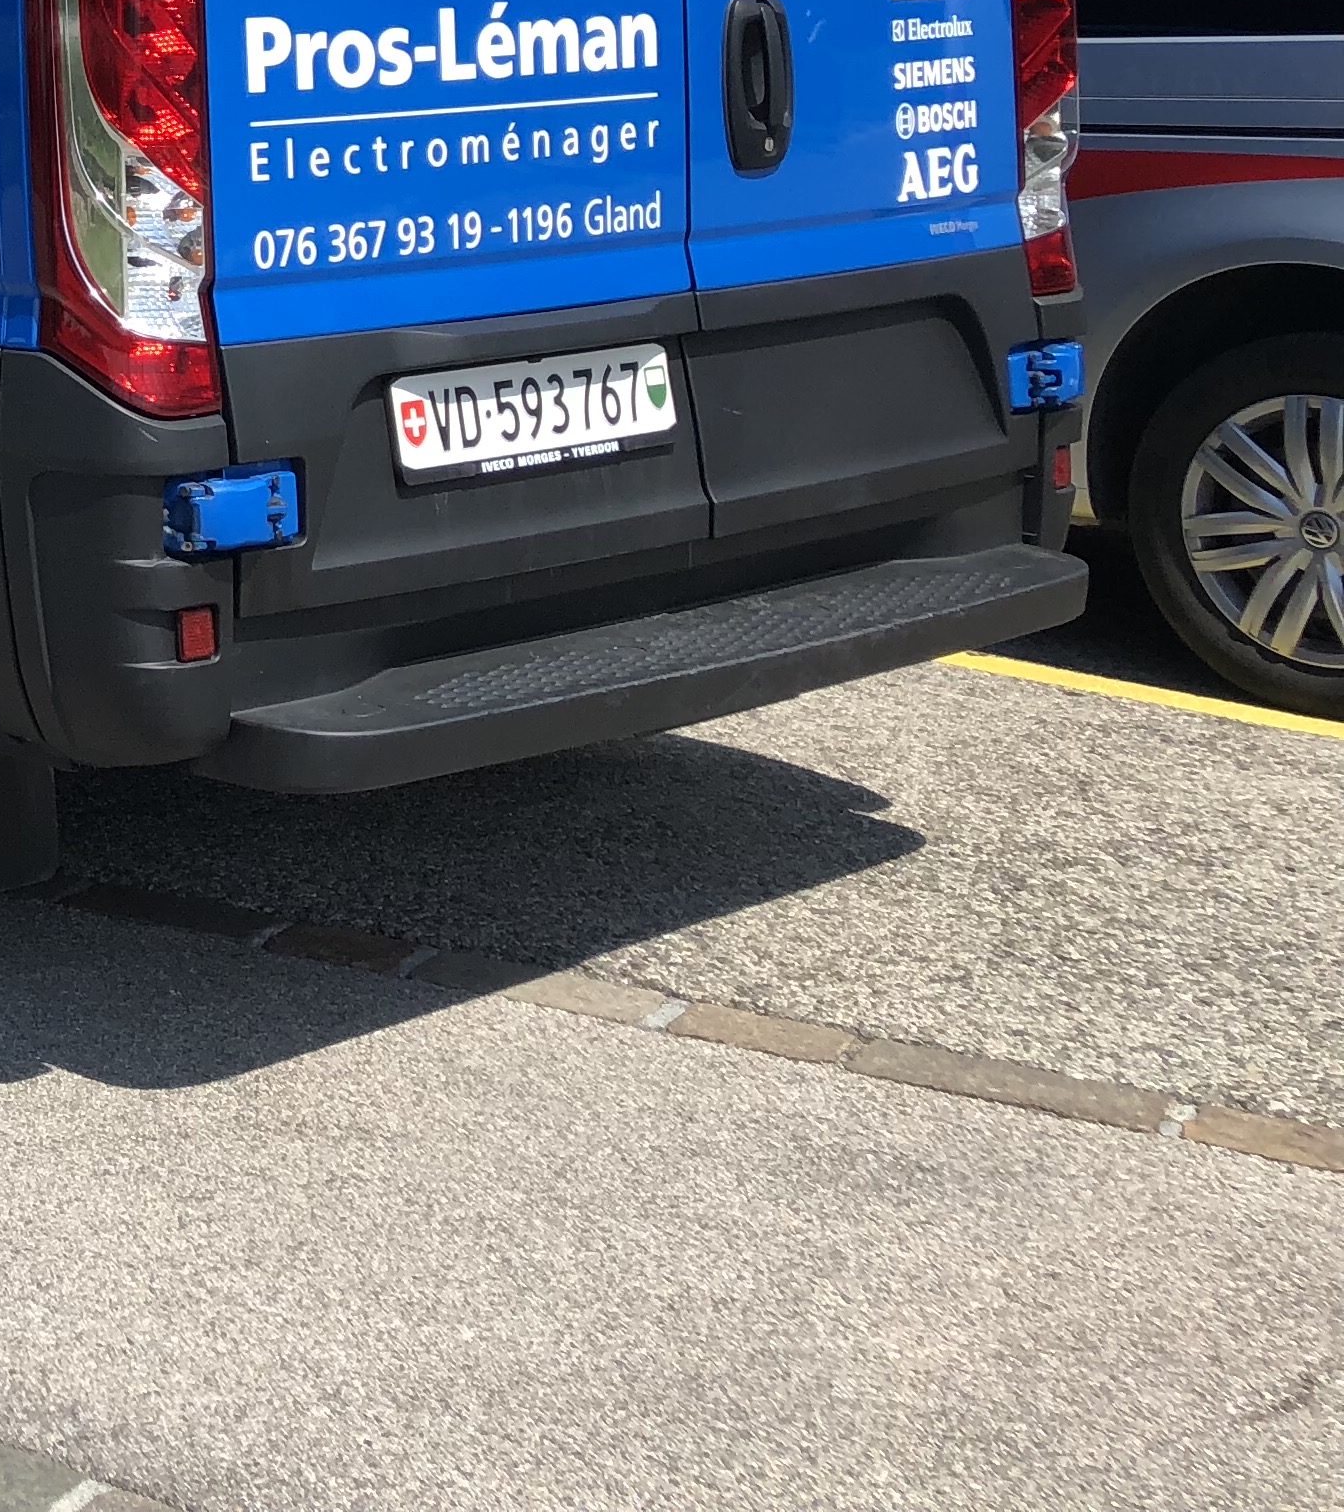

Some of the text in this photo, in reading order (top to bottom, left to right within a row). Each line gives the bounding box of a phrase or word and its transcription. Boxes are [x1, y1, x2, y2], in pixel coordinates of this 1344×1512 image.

[245, 1, 658, 94] Pros-Léman
[907, 14, 974, 41] Electrolux
[893, 55, 976, 90] SIEMENS
[916, 100, 977, 134] BOSCH
[250, 120, 660, 182] Electroménager
[897, 142, 979, 203] AEG
[253, 226, 318, 270] 076
[328, 220, 386, 263] 367
[397, 215, 435, 256] 93
[584, 190, 661, 236] Gland
[480, 457, 515, 473] IVECO
[517, 450, 562, 468] MORGES
[570, 440, 620, 459] YVERDON
